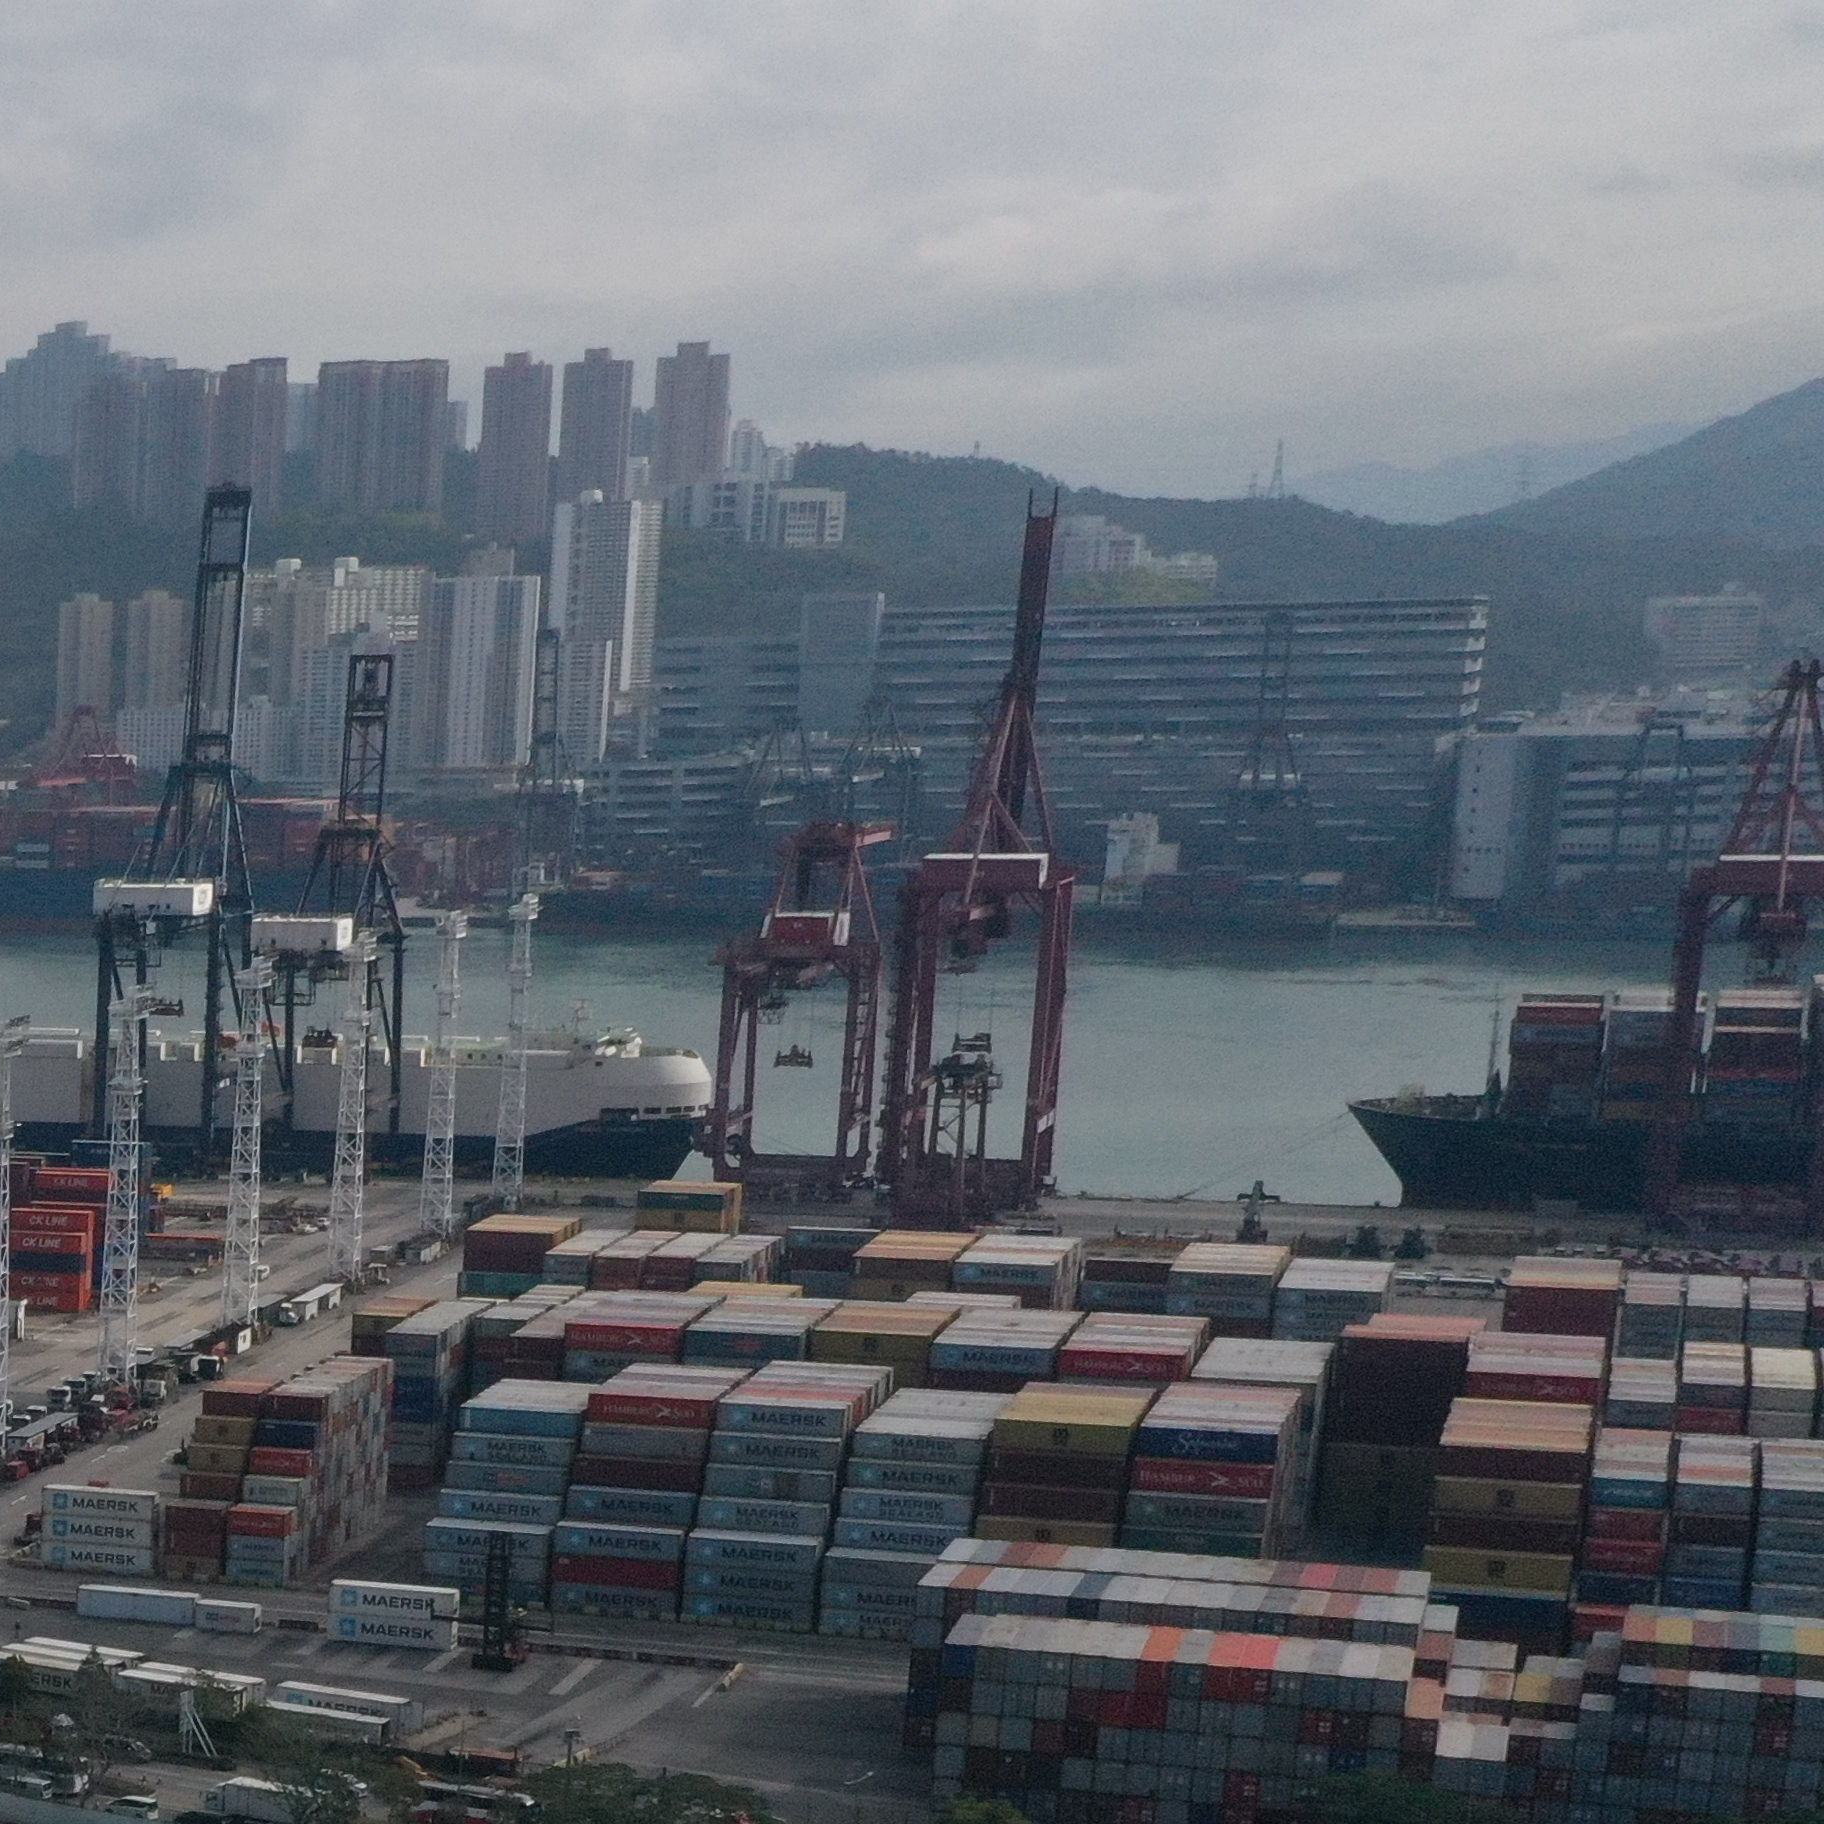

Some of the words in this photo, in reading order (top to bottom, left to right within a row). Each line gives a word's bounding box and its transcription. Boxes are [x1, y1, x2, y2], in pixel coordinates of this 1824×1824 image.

[28, 1214, 42, 1226] CK
[44, 1214, 69, 1227] LINE
[21, 1236, 37, 1248] CK
[39, 1237, 62, 1249] LINE
[751, 1411, 827, 1428] MAERSK
[746, 1444, 820, 1460] MAERSK
[881, 1470, 960, 1488] MAERSK
[71, 1496, 138, 1514] MAERSK
[470, 1501, 542, 1517] MAERSK
[602, 1498, 675, 1515] MAERSK
[70, 1523, 136, 1540] MAERSK
[870, 1530, 948, 1549] MAERSK
[589, 1534, 663, 1553] MAERSK
[70, 1550, 137, 1567] MAERSK
[721, 1546, 797, 1563] MAERSK
[720, 1574, 795, 1592] MAERSK
[717, 1603, 794, 1621] MAERSK
[360, 1622, 434, 1641] MAERSK
[32, 1672, 73, 1690] ERSK
